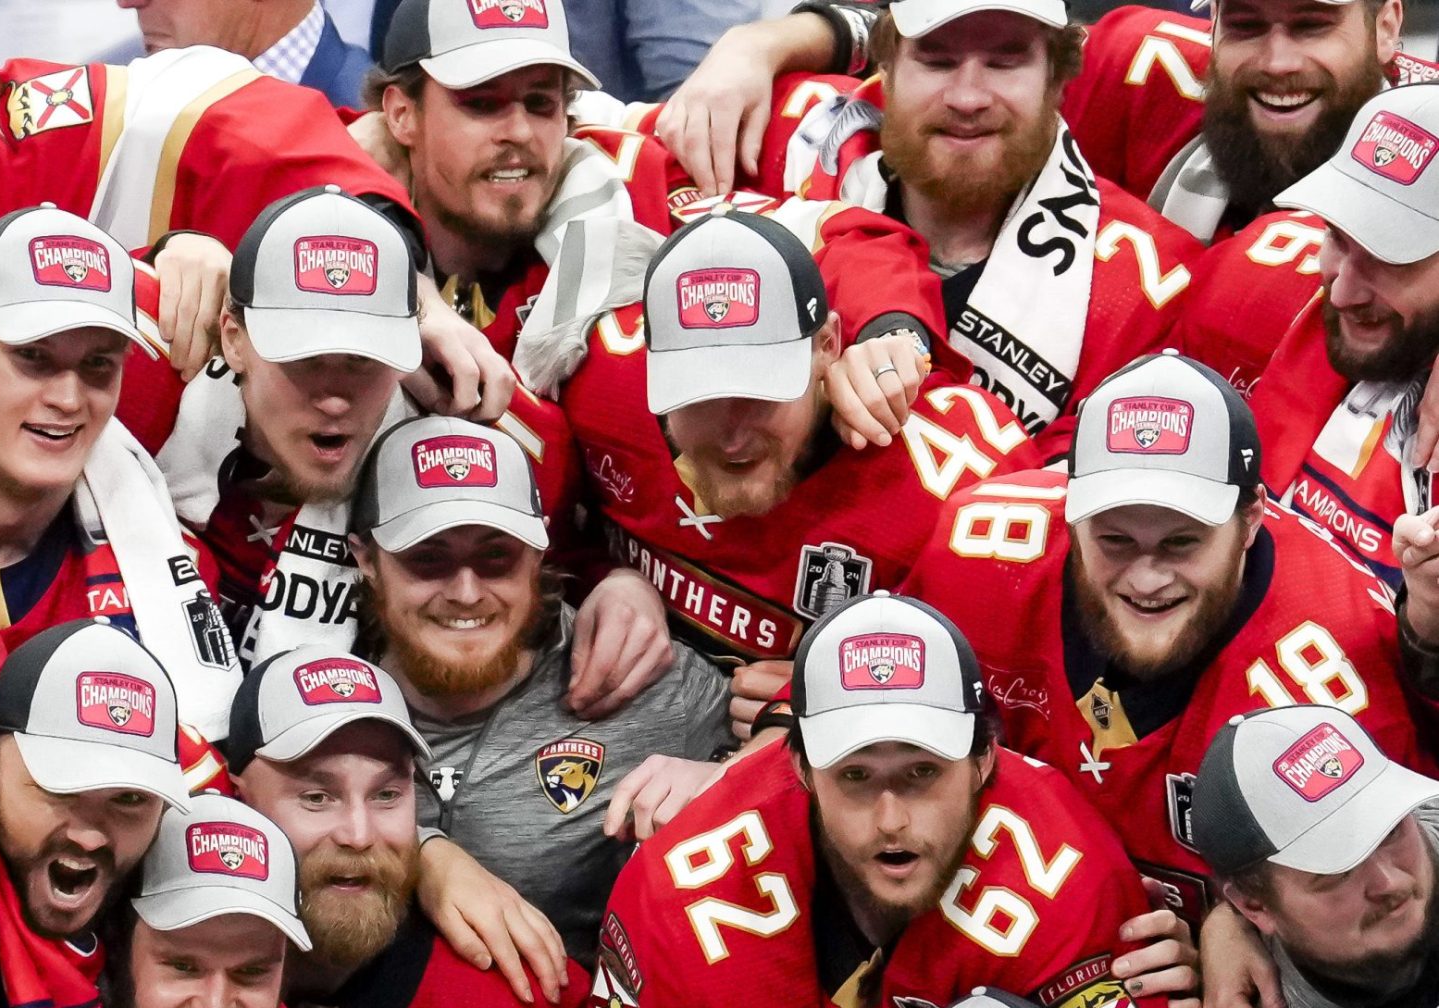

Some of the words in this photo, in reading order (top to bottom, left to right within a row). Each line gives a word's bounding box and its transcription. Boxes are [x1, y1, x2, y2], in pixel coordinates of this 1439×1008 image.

[1361, 121, 1430, 169] CHAMPIONS
[36, 247, 108, 276] CHAMPIONS
[299, 249, 373, 277] CHAMPIONS
[681, 282, 755, 310] CHAMPIONS
[957, 310, 1065, 397] STANLEY
[1111, 410, 1187, 437] CHAMPIONS
[418, 447, 493, 473] CHAMPIONS
[899, 385, 1030, 501] 42
[949, 482, 1067, 563] 18
[809, 564, 823, 574] 20
[845, 571, 859, 581] 24
[628, 538, 777, 650] PANTHERS
[844, 647, 920, 673] CHAMPIONS
[856, 640, 887, 649] STANLEY
[301, 668, 376, 693] CHAMPIONS
[1246, 620, 1369, 716] 18
[81, 685, 152, 719] CHAMPIONS
[1285, 732, 1351, 788] CHAMPIONS
[192, 833, 265, 865] CHAMPIONS
[664, 810, 801, 966] 62
[939, 803, 1082, 958] 62
[609, 922, 637, 981] FLORIDA
[1047, 960, 1107, 1000] FLORIDA
